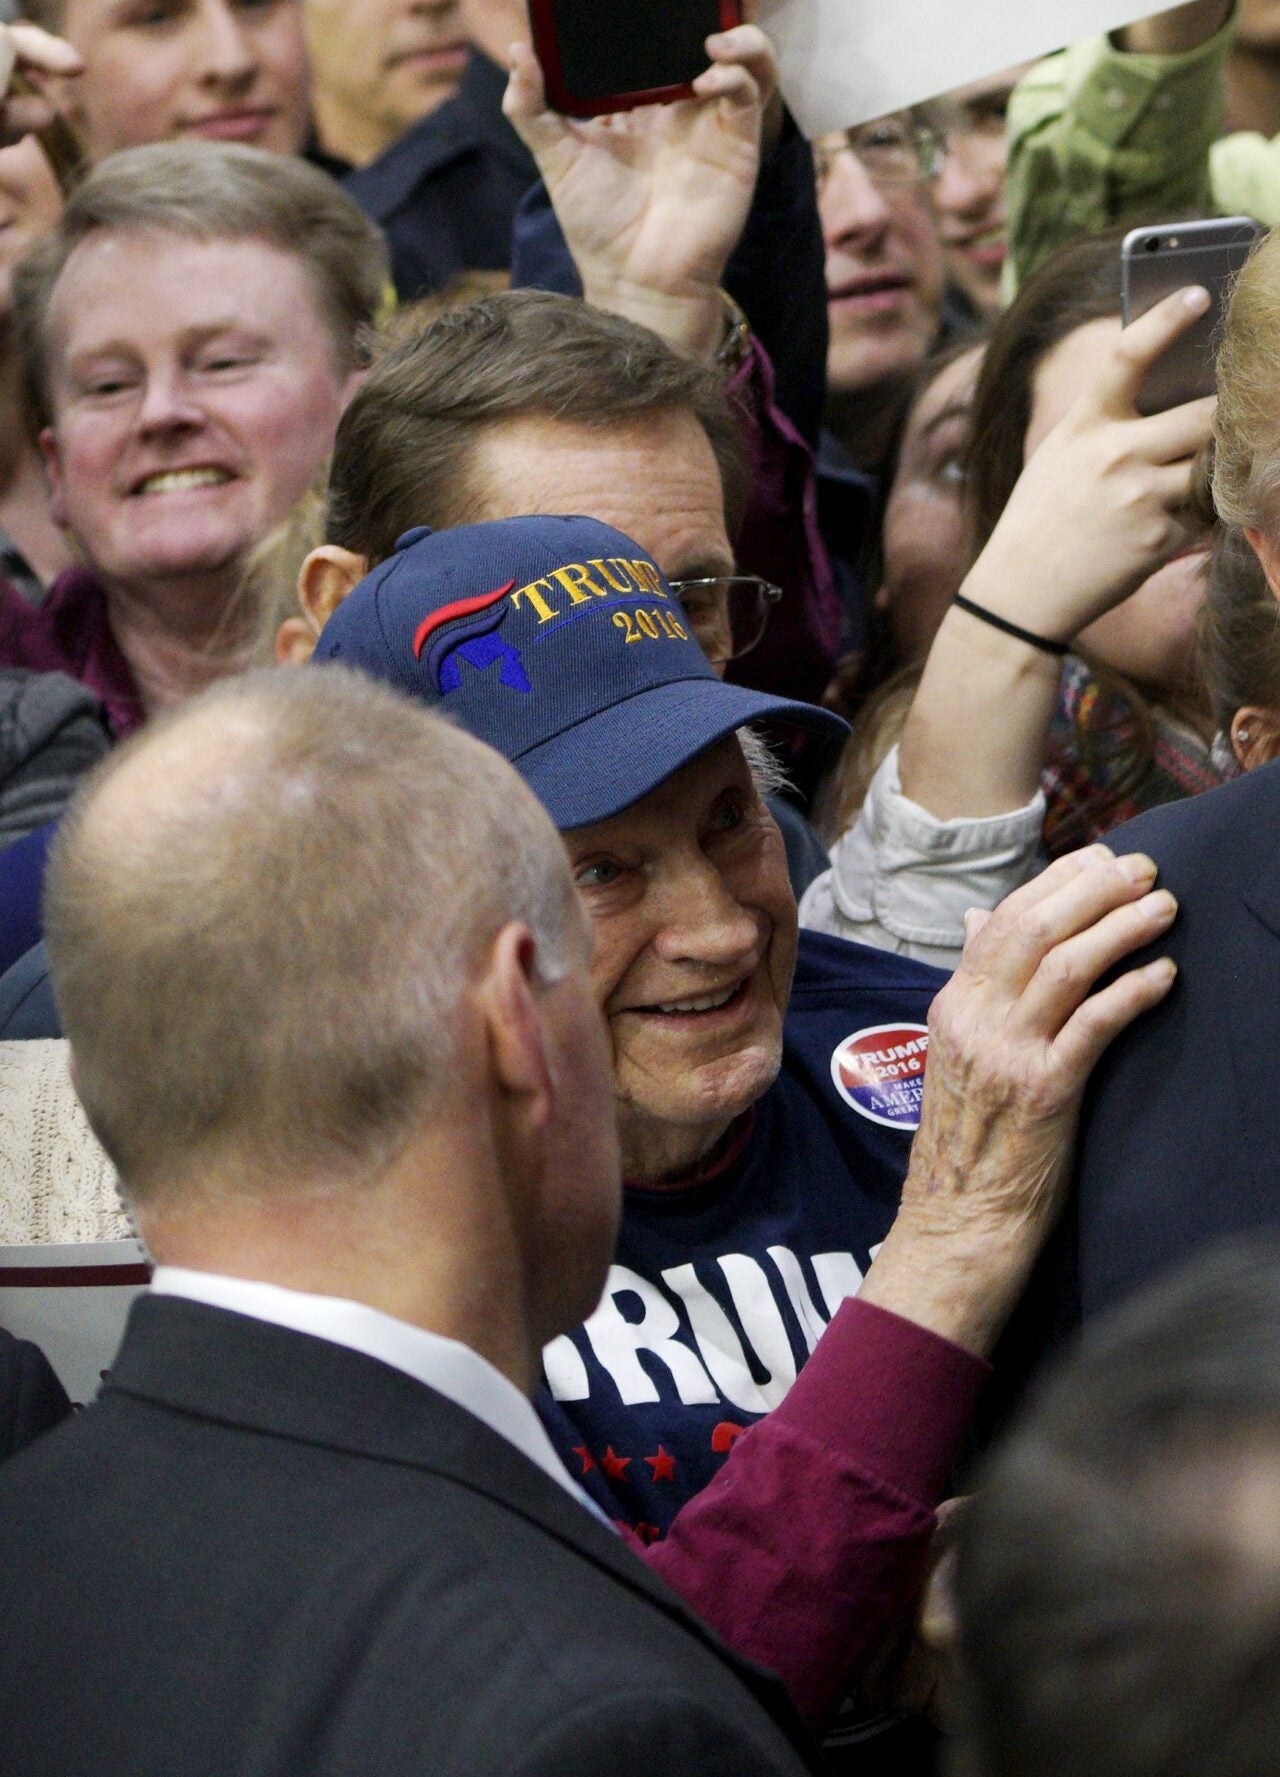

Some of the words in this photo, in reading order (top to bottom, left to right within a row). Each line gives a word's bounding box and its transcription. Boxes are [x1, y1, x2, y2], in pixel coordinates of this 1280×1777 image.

[510, 557, 668, 625] TRUMP
[612, 608, 689, 644] 2016
[876, 1058, 921, 1078] 2016
[893, 1078, 923, 1090] MAKE
[887, 1104, 920, 1117] GREAT
